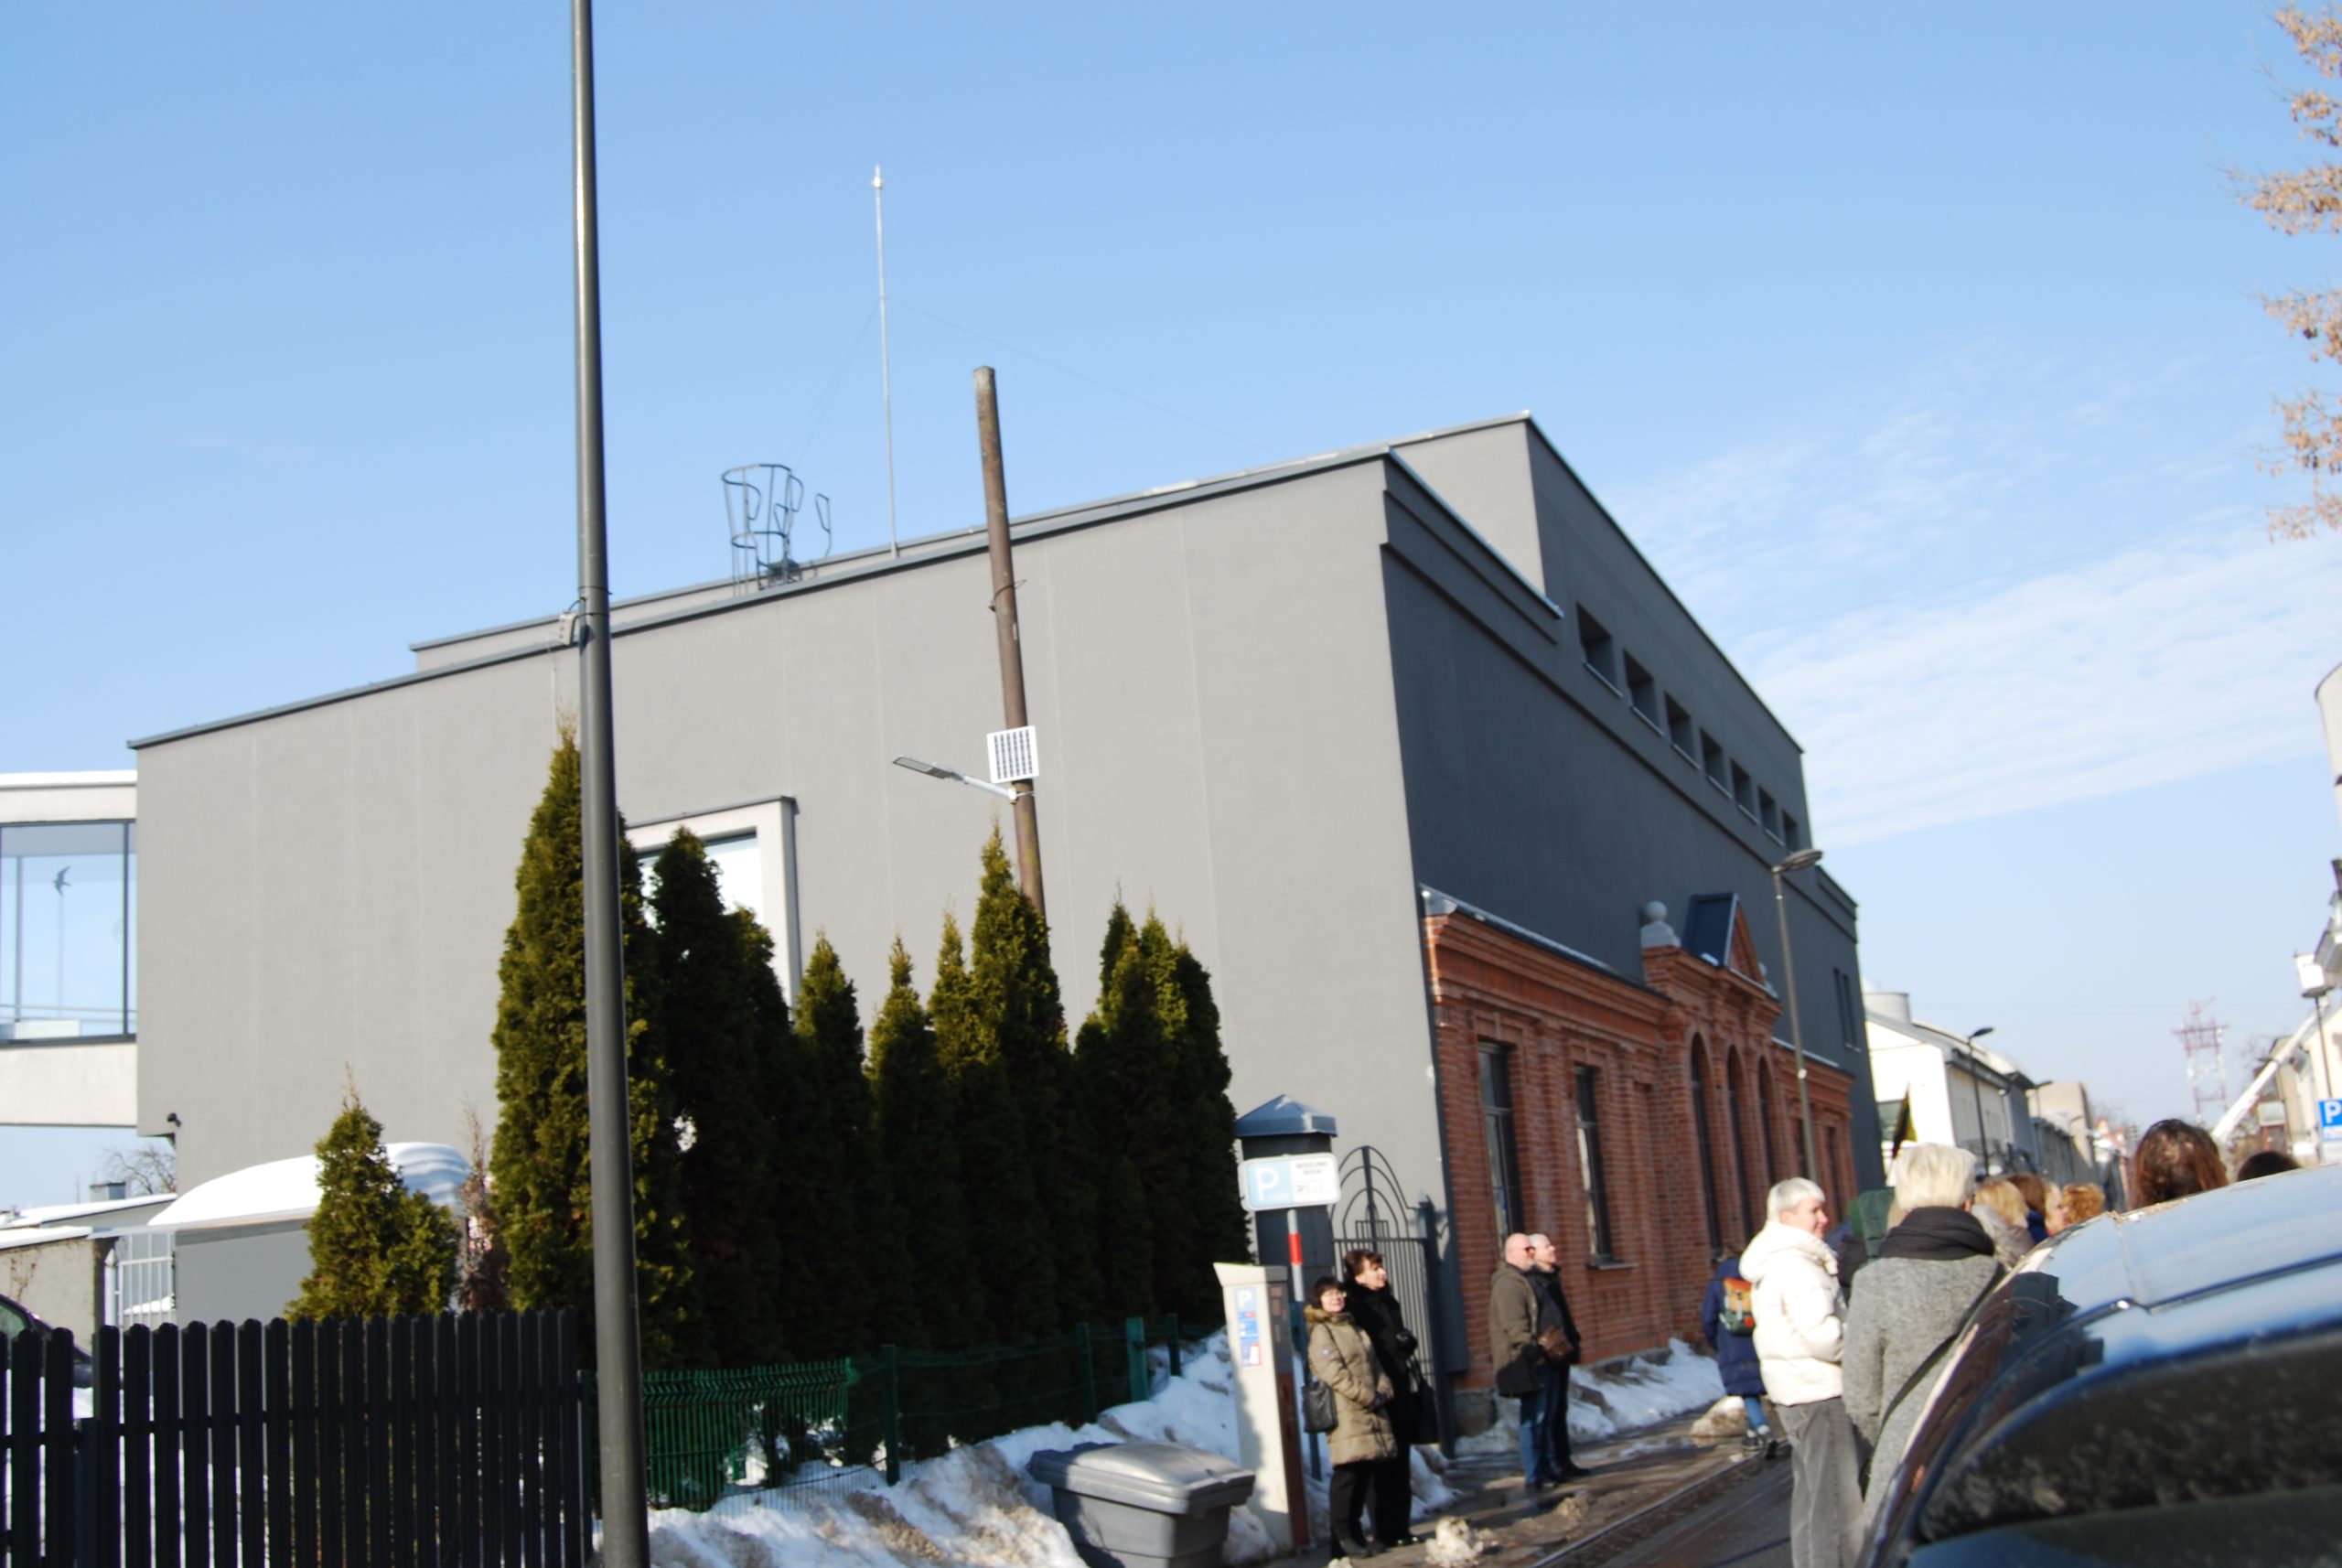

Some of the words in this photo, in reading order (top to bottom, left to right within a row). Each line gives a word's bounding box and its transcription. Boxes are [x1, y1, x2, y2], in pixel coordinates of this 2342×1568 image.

[2326, 1101, 2340, 1123] P
[1256, 1167, 1279, 1200] P
[1238, 1290, 1252, 1307] P
